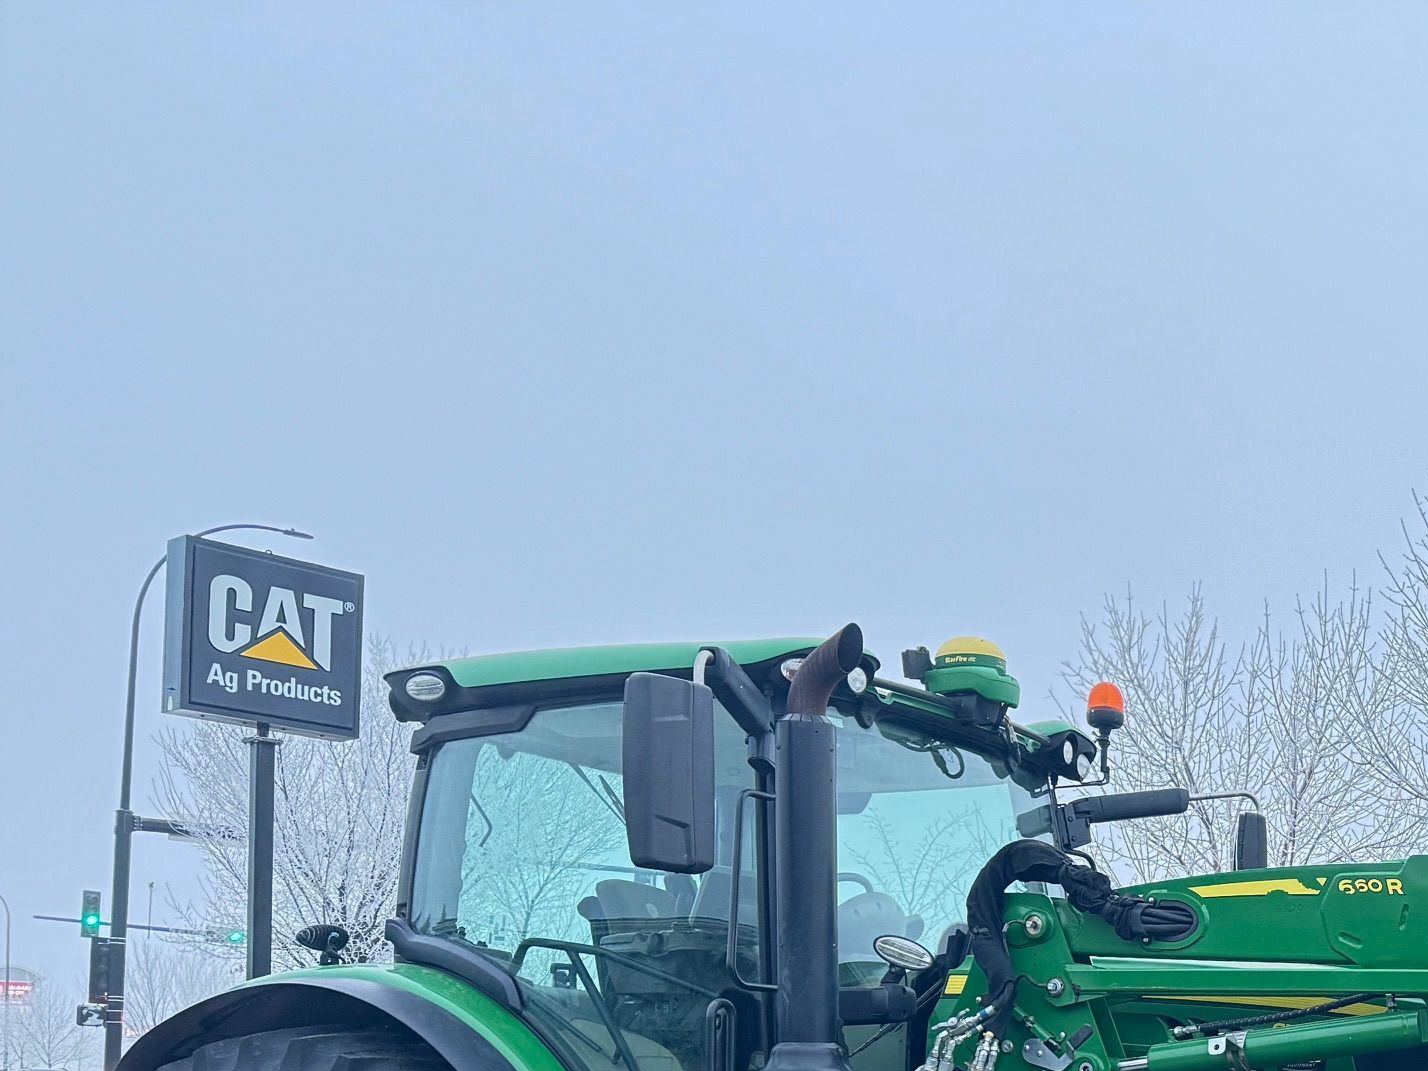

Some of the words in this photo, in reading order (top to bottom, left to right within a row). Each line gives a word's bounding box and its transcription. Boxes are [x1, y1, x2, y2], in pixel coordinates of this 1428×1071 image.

[209, 574, 343, 672] CAT
[206, 662, 238, 693] Ag
[246, 669, 342, 706] Products
